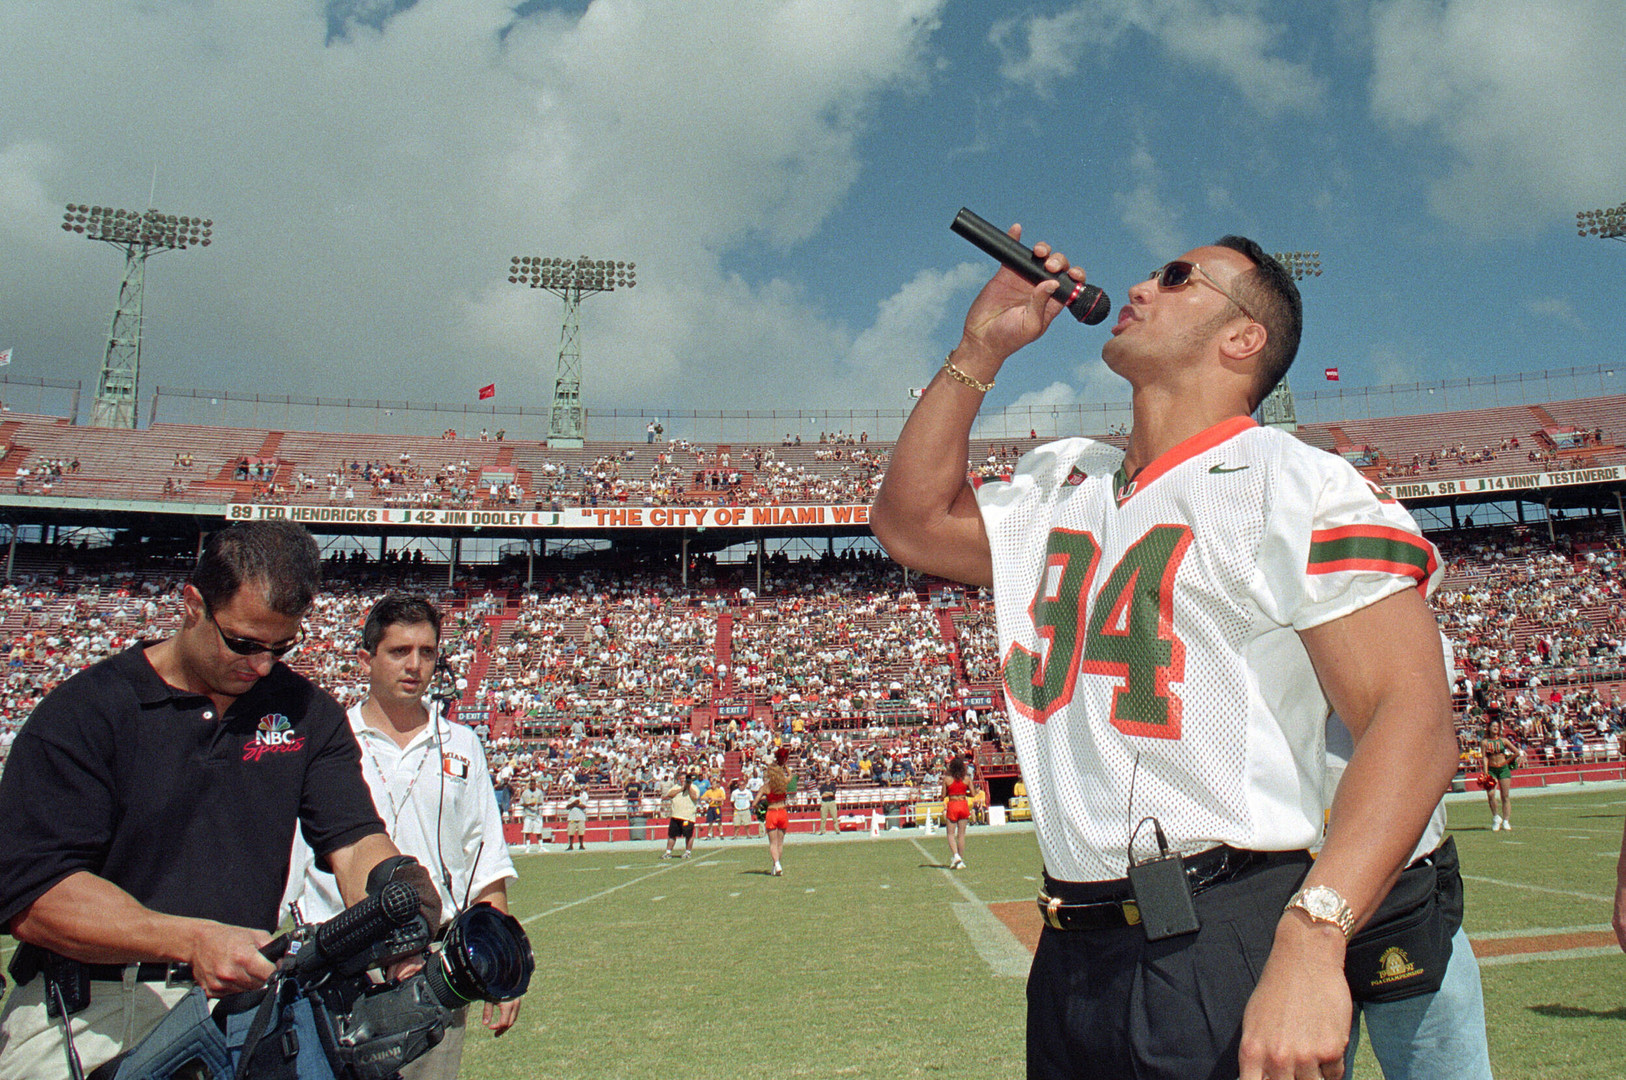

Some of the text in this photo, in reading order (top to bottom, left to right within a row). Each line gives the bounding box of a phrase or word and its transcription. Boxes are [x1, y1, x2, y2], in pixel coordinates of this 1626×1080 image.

[1488, 467, 1620, 490] 14 VINNY TESTAVERDE
[1438, 482, 1456, 494] SR
[231, 505, 378, 522] 89 TED HENDRICKS
[415, 510, 526, 526] 42 JIM DOOLEY
[581, 506, 873, 526] "THE CITY OF MIAMI WE
[1001, 523, 1195, 741] 94
[255, 729, 296, 746] NBC
[242, 736, 307, 762] Sports
[442, 751, 471, 767] MIAMI
